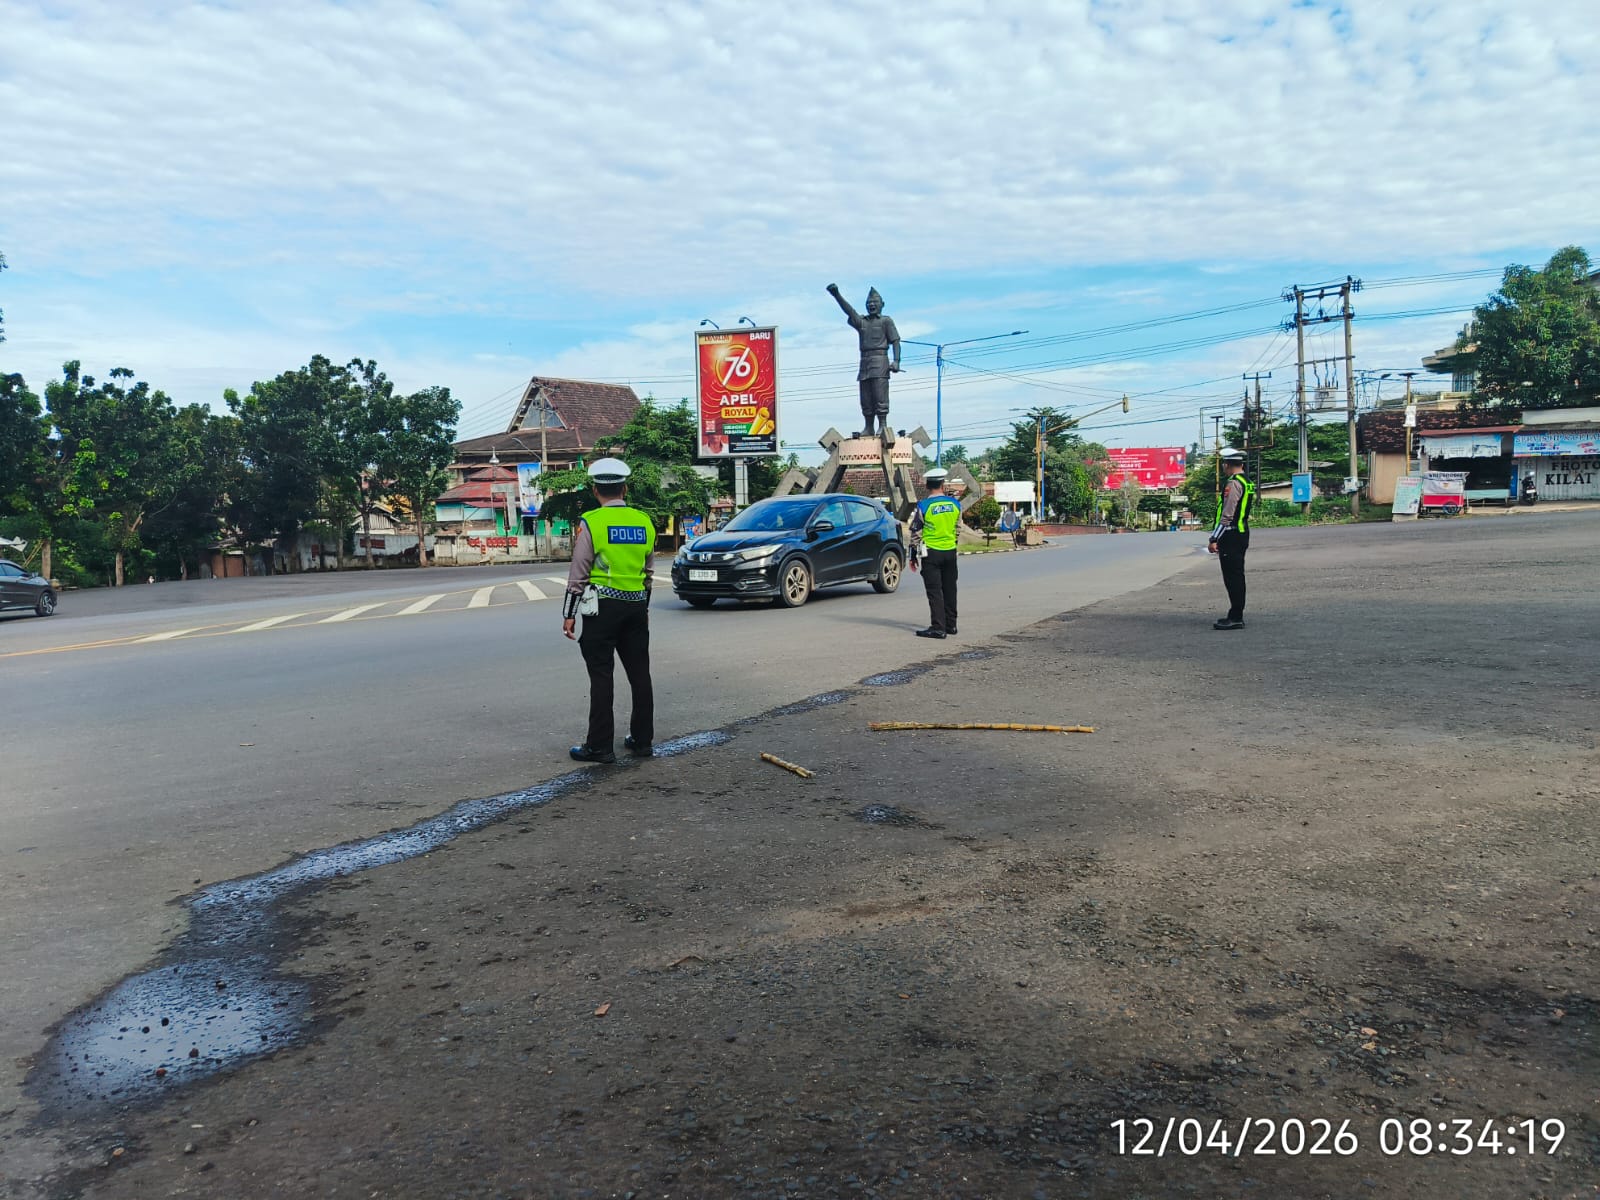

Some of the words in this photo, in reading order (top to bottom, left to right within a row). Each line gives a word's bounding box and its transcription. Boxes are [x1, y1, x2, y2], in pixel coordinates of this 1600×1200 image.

[749, 332, 771, 340] BARU
[722, 347, 751, 386] 76
[720, 394, 757, 406] APEL
[724, 408, 754, 417] ROYAL
[1552, 461, 1600, 471] FHOTO
[1545, 472, 1596, 485] KILAT
[610, 528, 646, 542] POLISI
